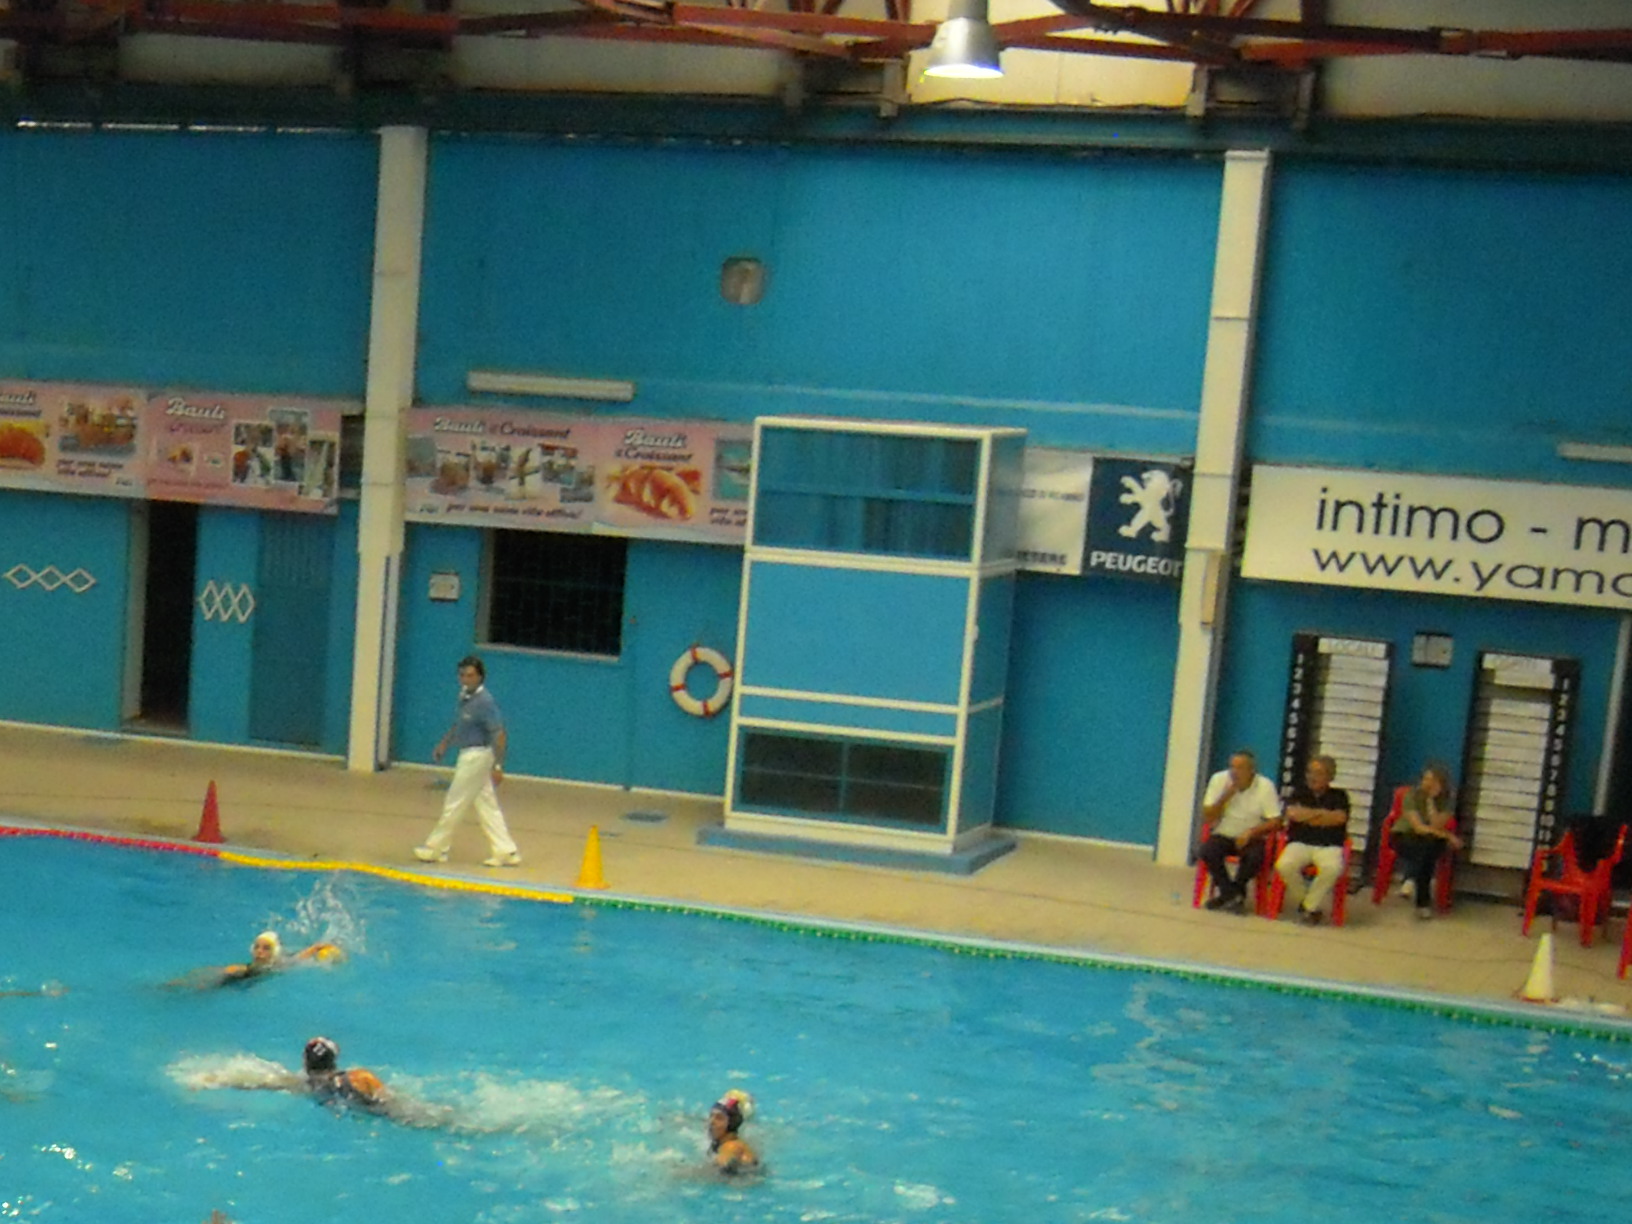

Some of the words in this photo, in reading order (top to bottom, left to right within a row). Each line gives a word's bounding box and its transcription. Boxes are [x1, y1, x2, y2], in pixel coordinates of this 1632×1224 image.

[165, 397, 226, 420] Bauli
[624, 428, 689, 448] Bauli
[1316, 486, 1505, 544] intimo
[1090, 551, 1184, 578] PEUGEOT
